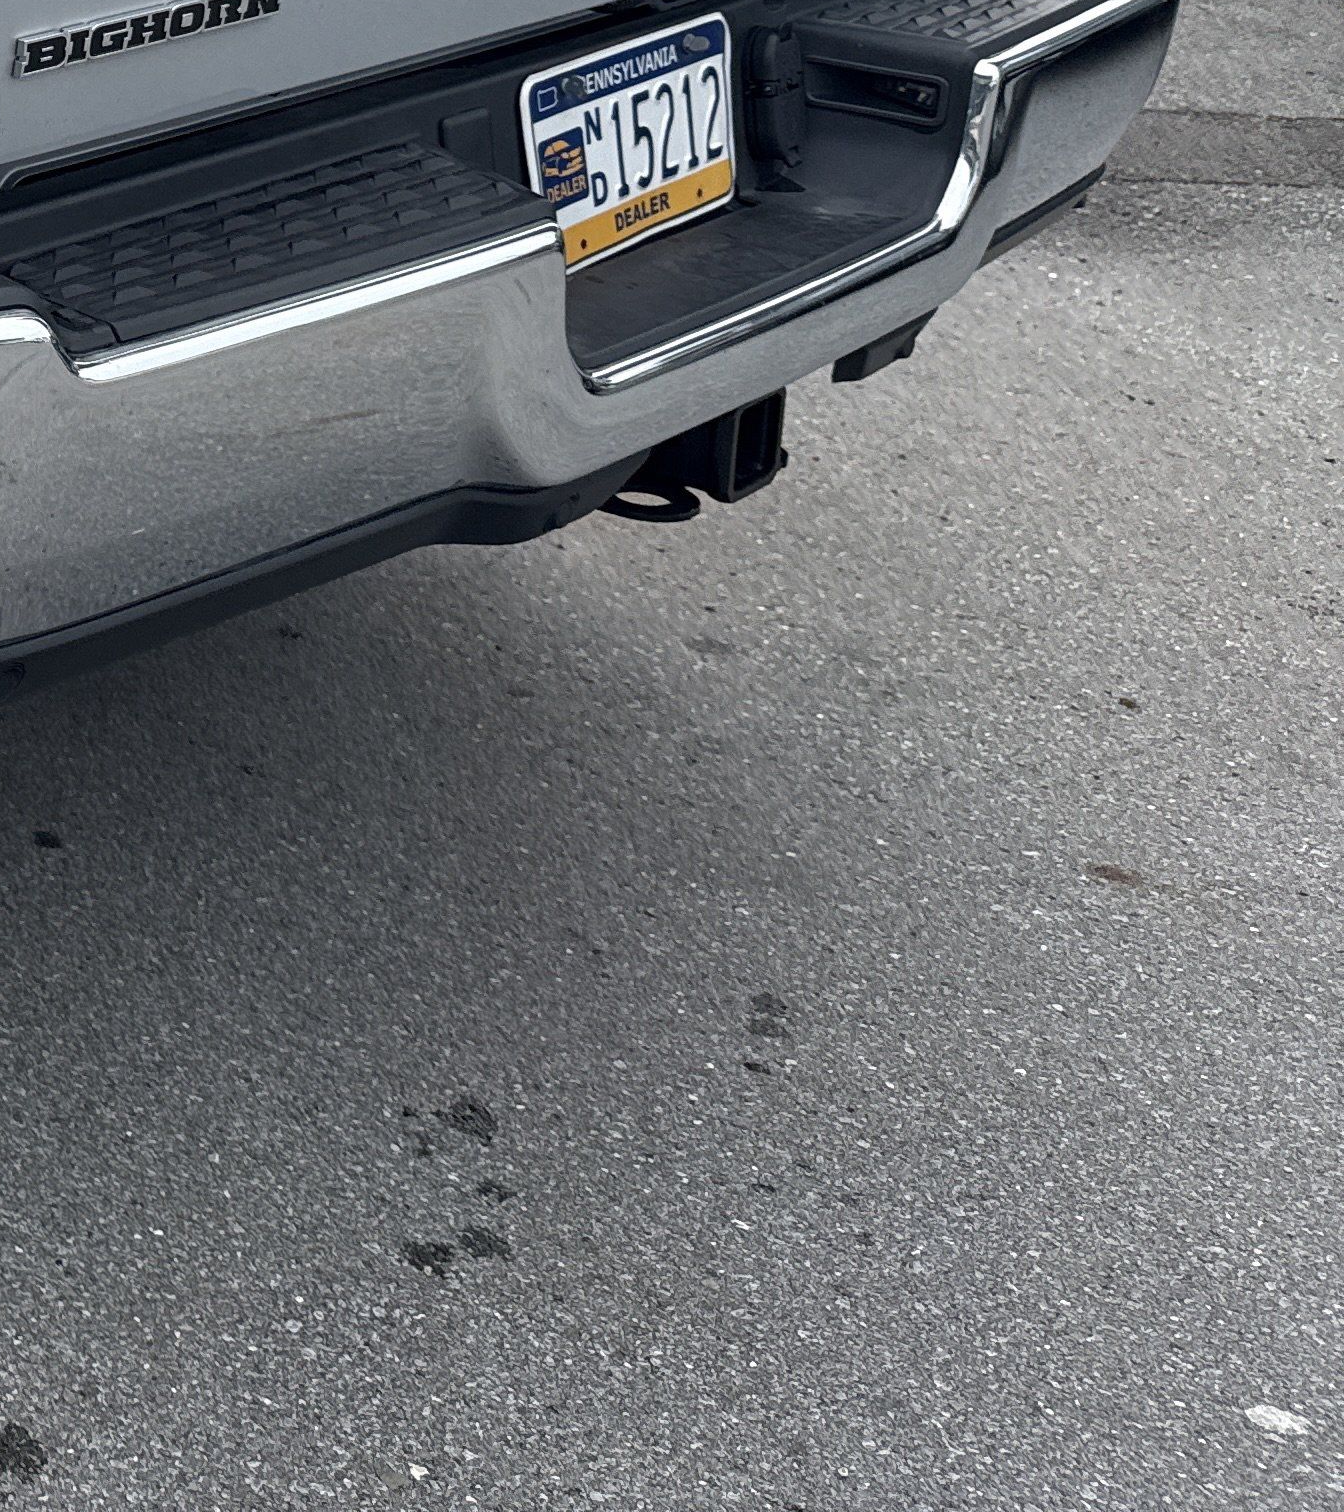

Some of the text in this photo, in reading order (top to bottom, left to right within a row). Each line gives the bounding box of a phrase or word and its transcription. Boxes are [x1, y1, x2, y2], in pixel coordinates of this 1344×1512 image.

[578, 45, 678, 95] ENNSYLVANIA
[612, 66, 723, 198] 15212
[547, 173, 588, 204] DEALER
[614, 191, 672, 233] DEALER
